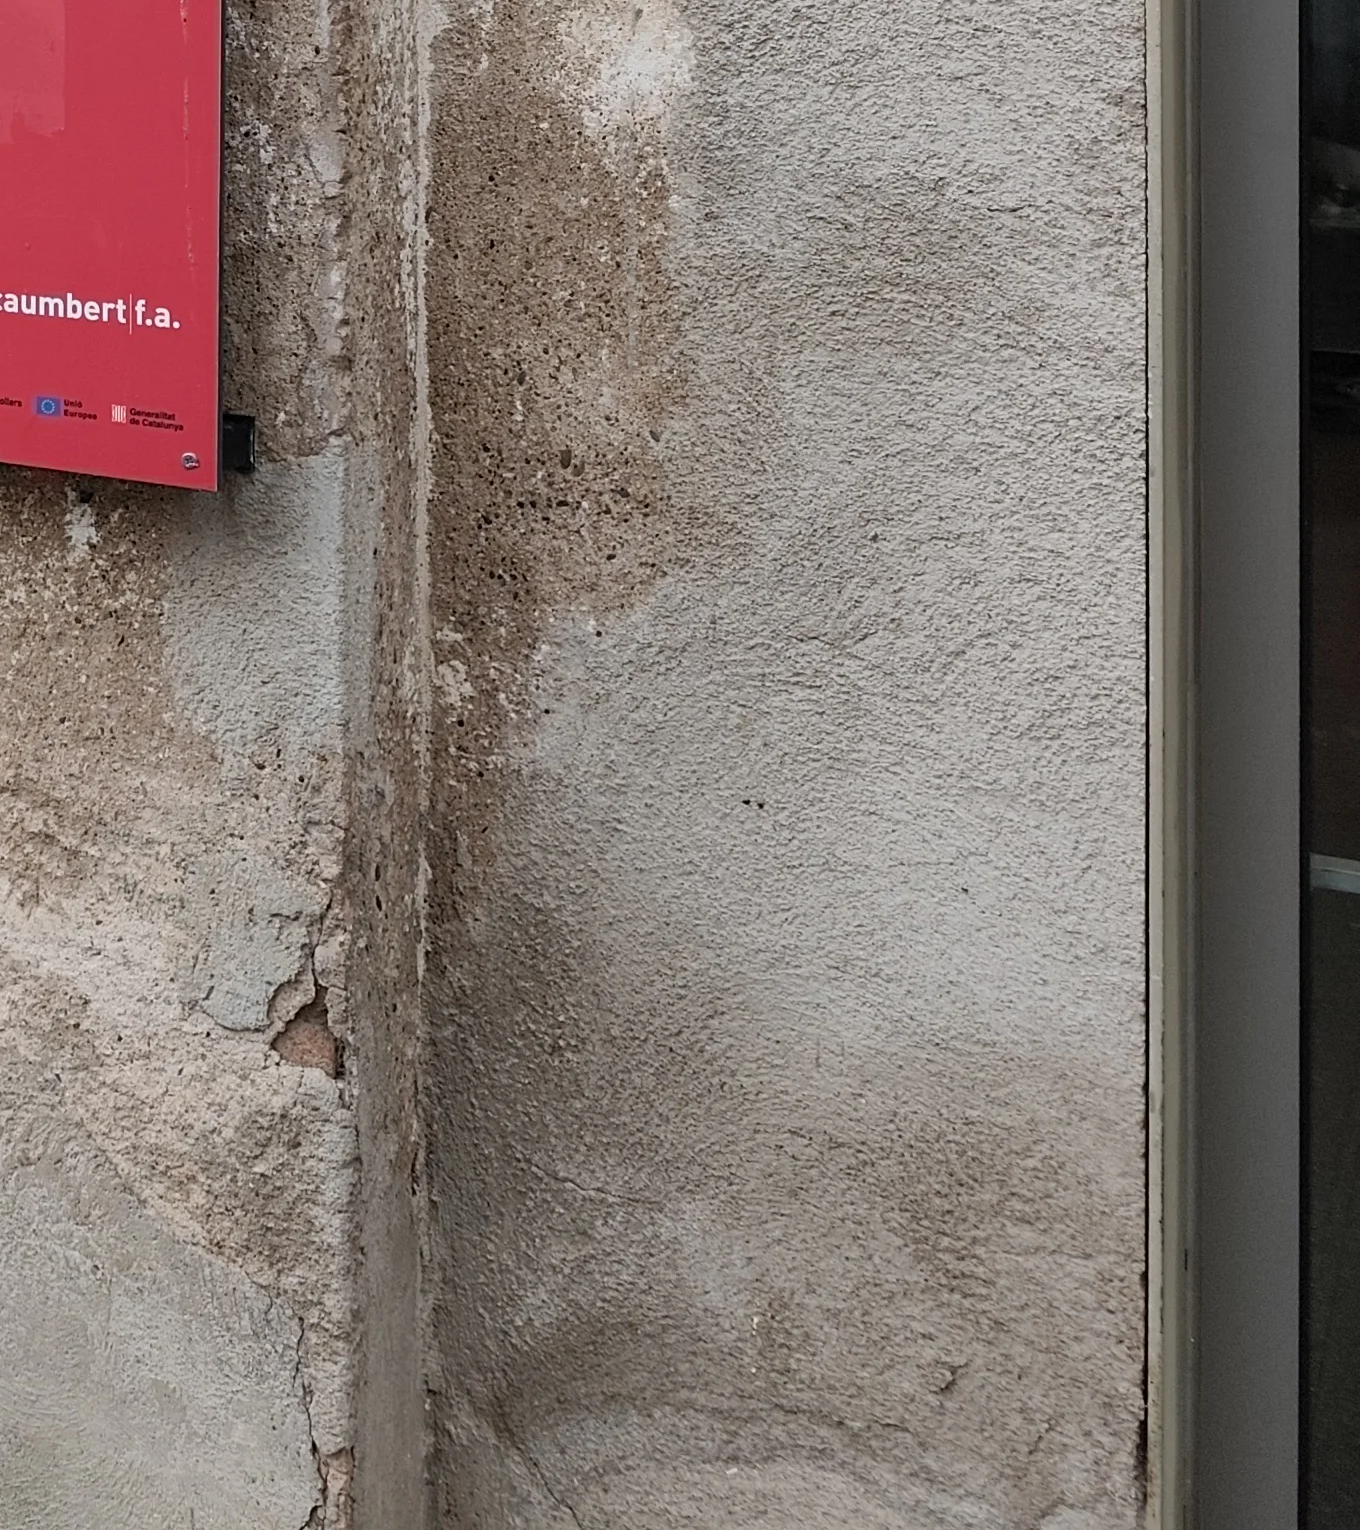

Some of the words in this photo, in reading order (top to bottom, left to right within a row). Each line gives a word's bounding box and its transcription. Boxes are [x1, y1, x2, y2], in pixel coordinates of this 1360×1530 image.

[135, 299, 181, 329] f.a.
[64, 399, 83, 409] Unió
[129, 408, 176, 421] Generalitat
[129, 417, 140, 426] de
[142, 419, 184, 432] Catalunya
